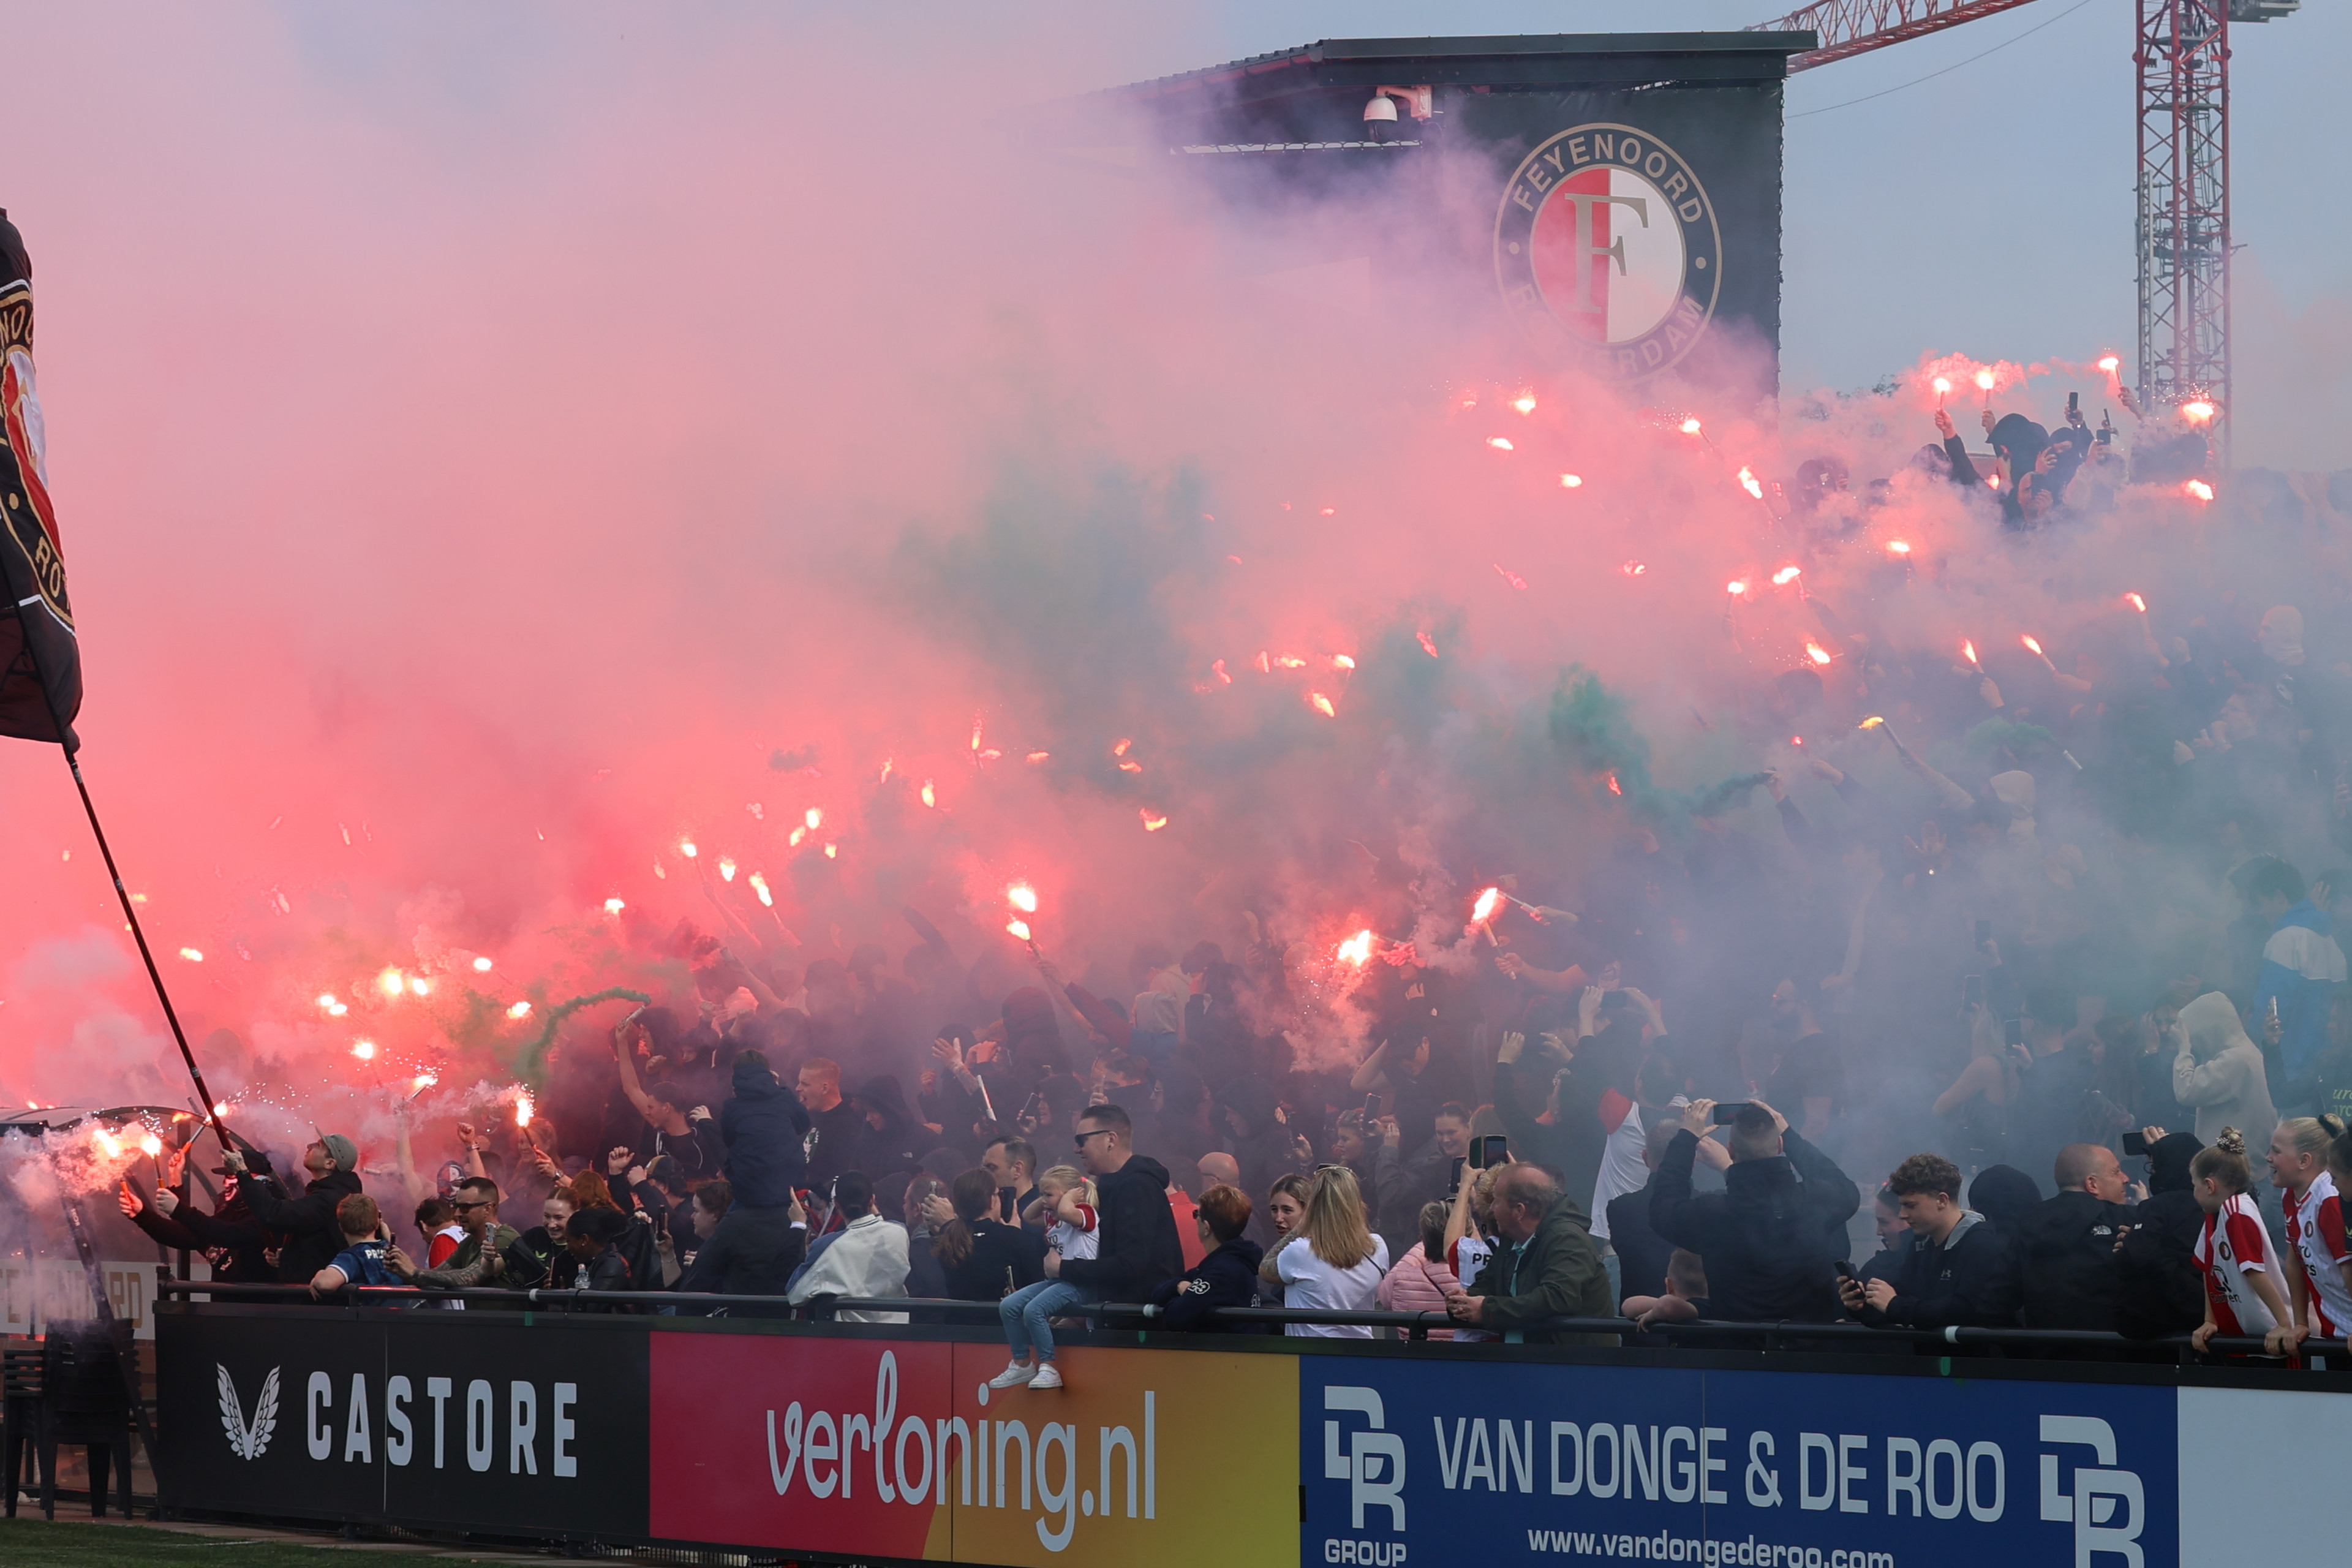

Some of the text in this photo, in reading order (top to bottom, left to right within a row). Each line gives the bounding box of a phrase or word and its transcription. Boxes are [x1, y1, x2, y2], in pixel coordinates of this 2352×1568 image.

[1513, 134, 1703, 223] FEYENOORD
[1510, 283, 1704, 378] ROTERDAM
[307, 1371, 577, 1477] CASTORE
[767, 1350, 1155, 1552] verloning.nl
[1434, 1417, 2005, 1522] VAN DONGE & DE ROO
[1325, 1539, 1407, 1567] GROUP
[1528, 1529, 1894, 1568] www.vandongederoo.com
